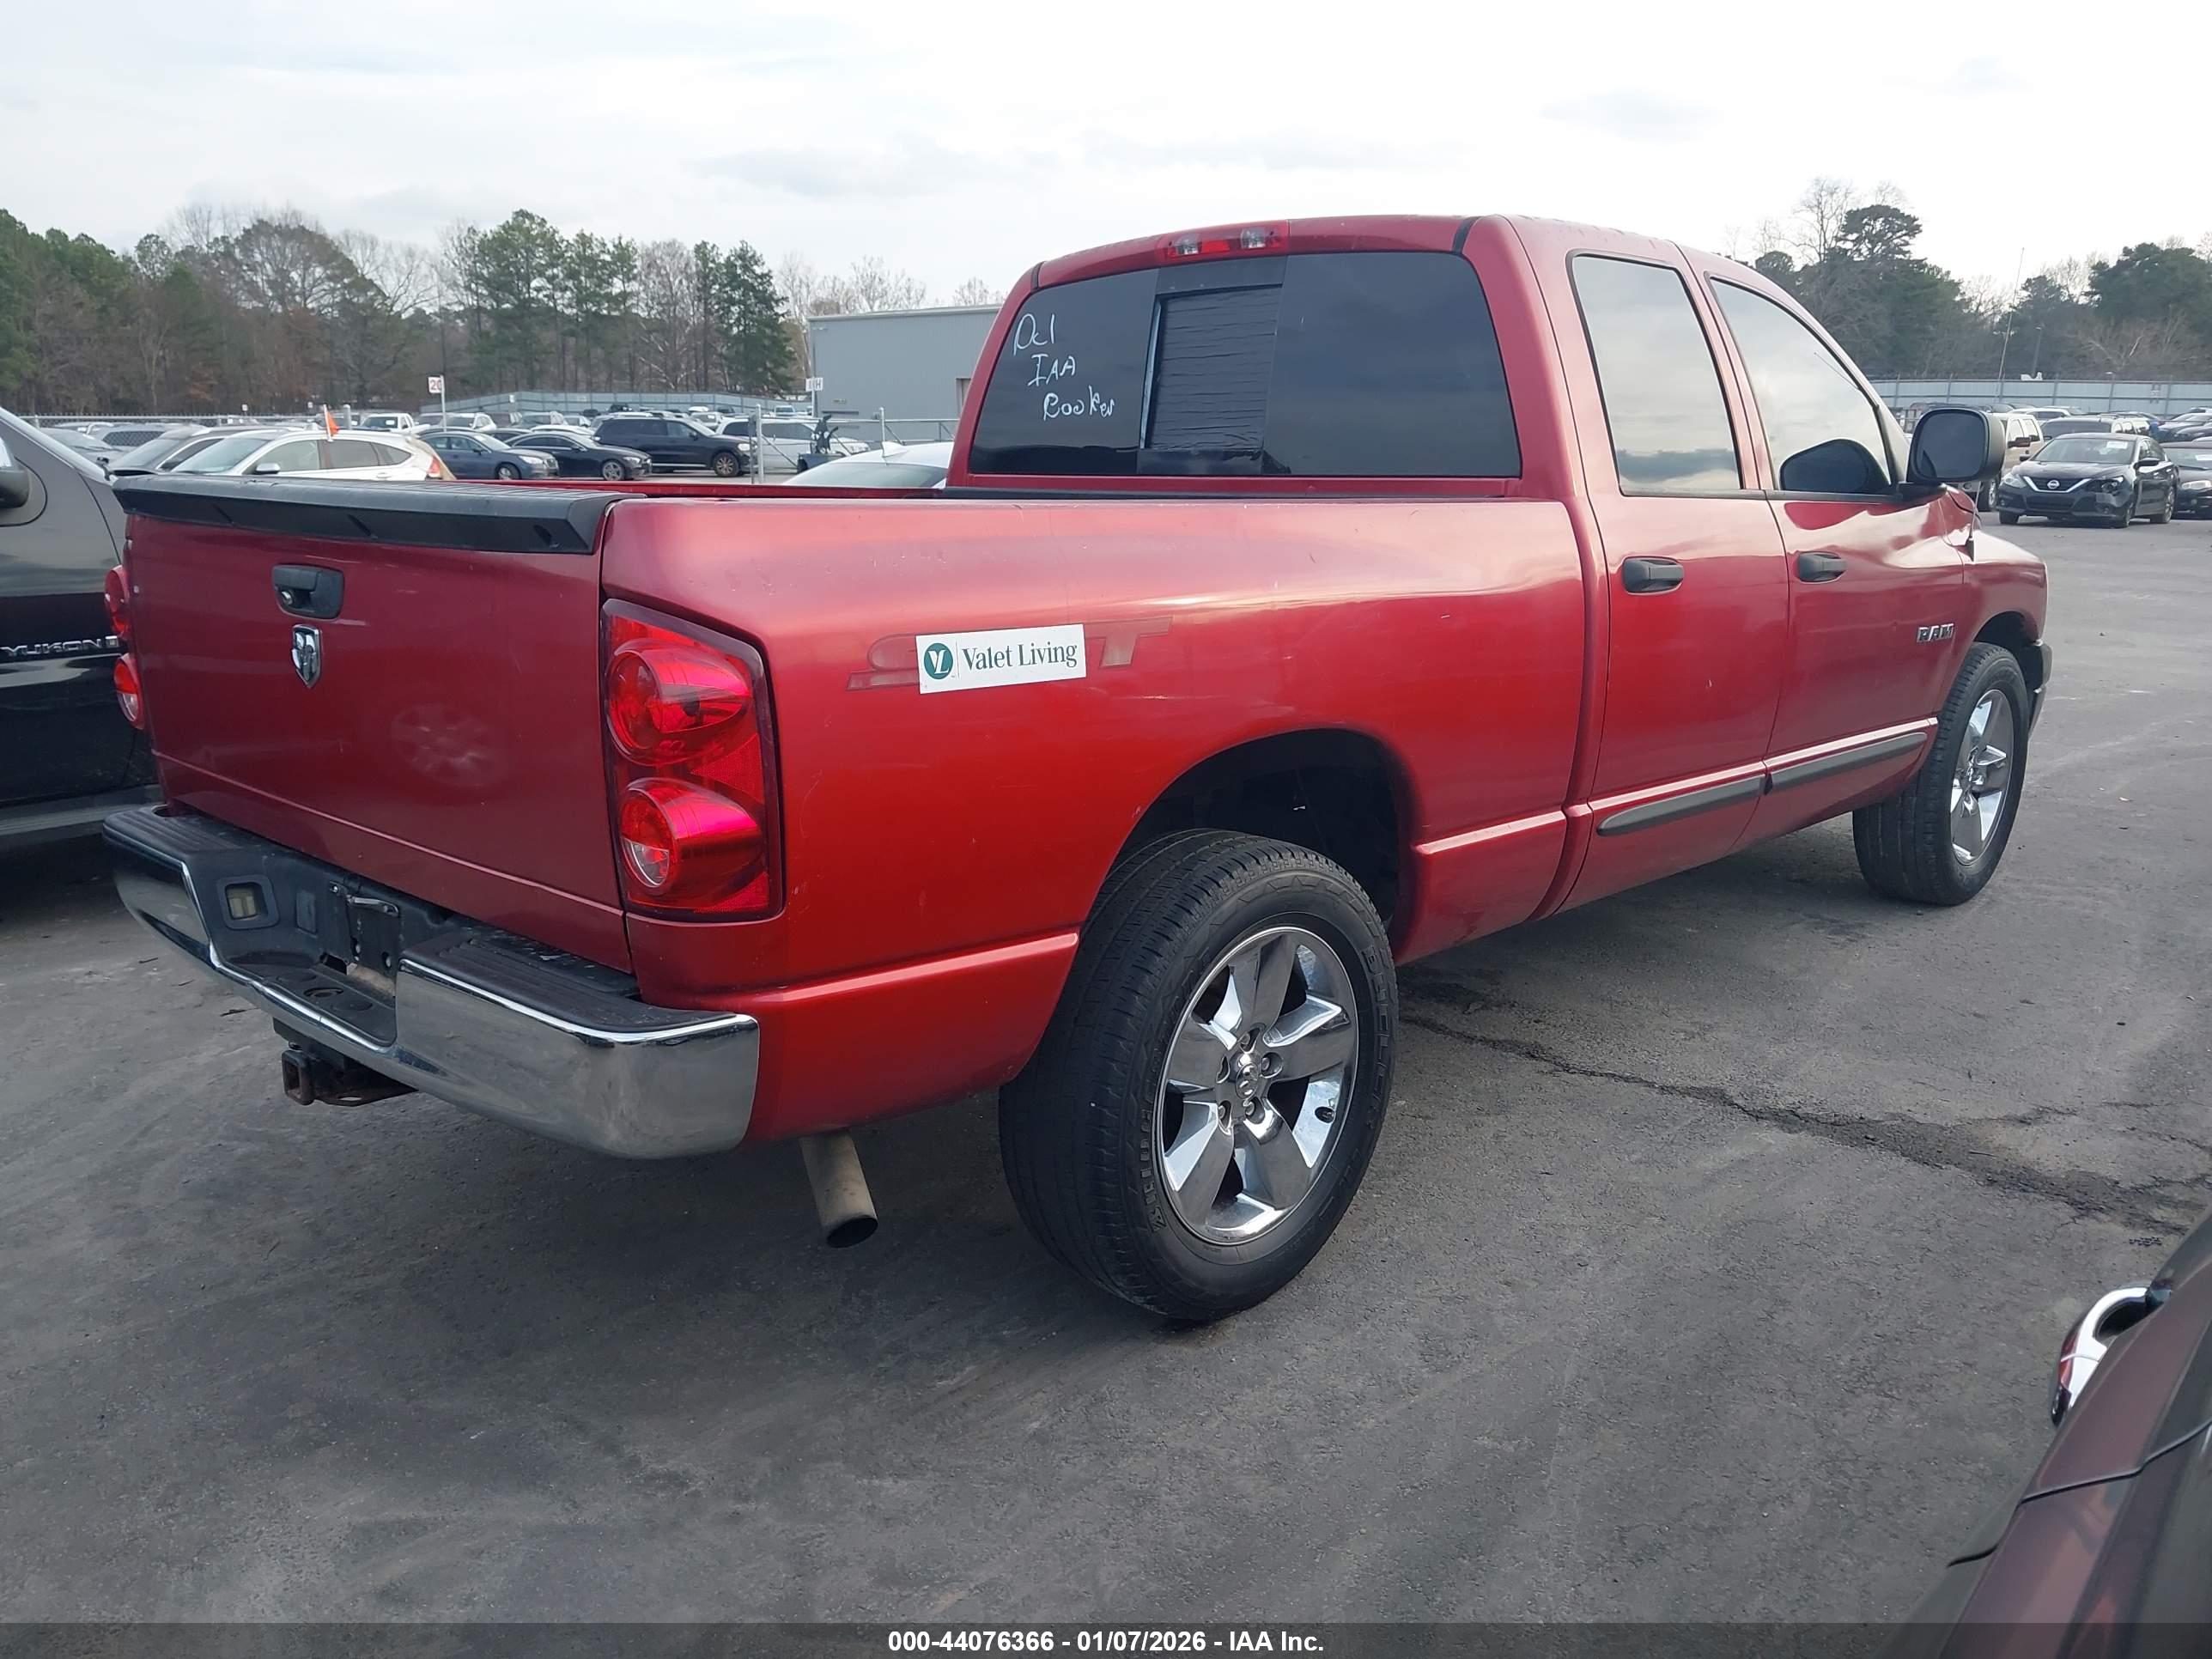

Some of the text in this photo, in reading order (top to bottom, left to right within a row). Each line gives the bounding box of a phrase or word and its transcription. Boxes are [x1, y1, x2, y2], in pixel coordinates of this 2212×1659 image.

[1027, 353, 1076, 386] IAA
[1917, 623, 1954, 643] RAM
[0, 639, 101, 656] YUKON
[962, 645, 1013, 671] Valet
[1018, 641, 1078, 668] Living
